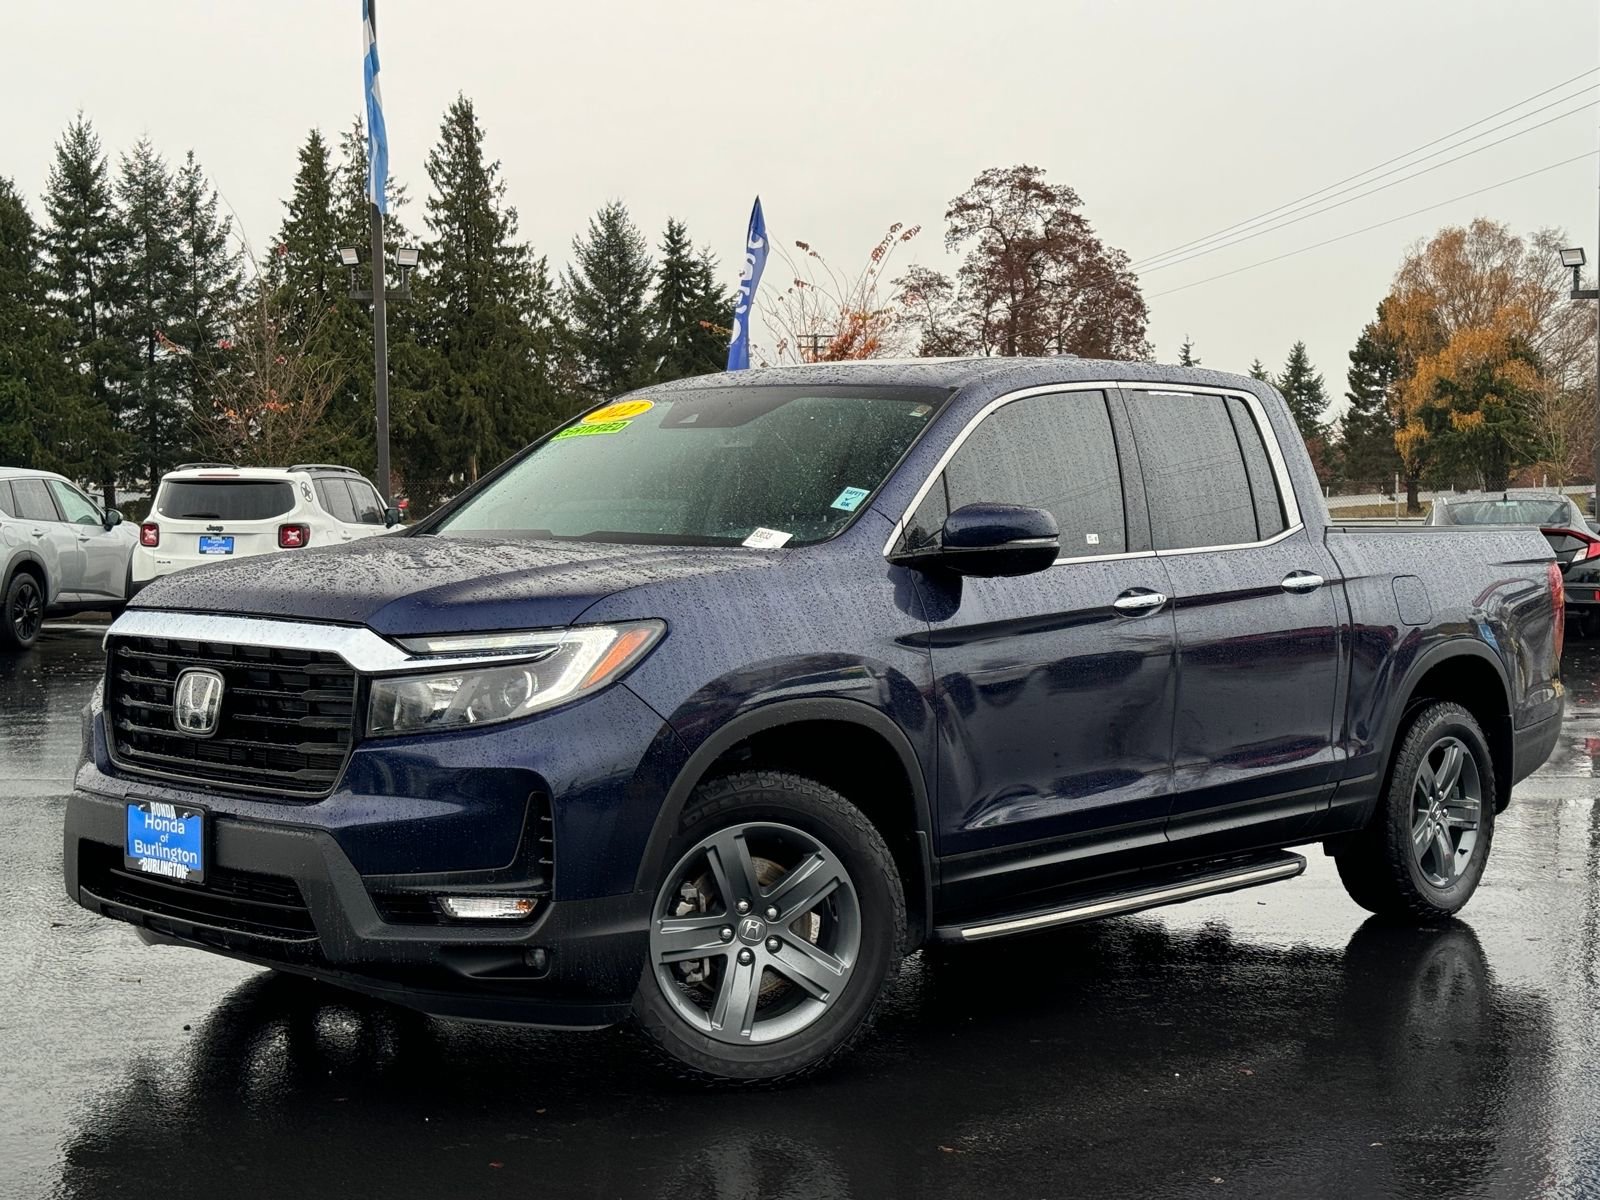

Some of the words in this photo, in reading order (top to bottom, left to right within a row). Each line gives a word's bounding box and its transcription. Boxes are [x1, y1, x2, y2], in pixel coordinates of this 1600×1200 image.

[845, 489, 865, 497] SAFETY
[206, 524, 224, 532] Jeep
[150, 801, 177, 820] HONDA
[144, 814, 185, 834] Honda
[160, 833, 169, 843] of
[134, 839, 198, 865] Burlington
[141, 857, 188, 880] BURLINGTON
